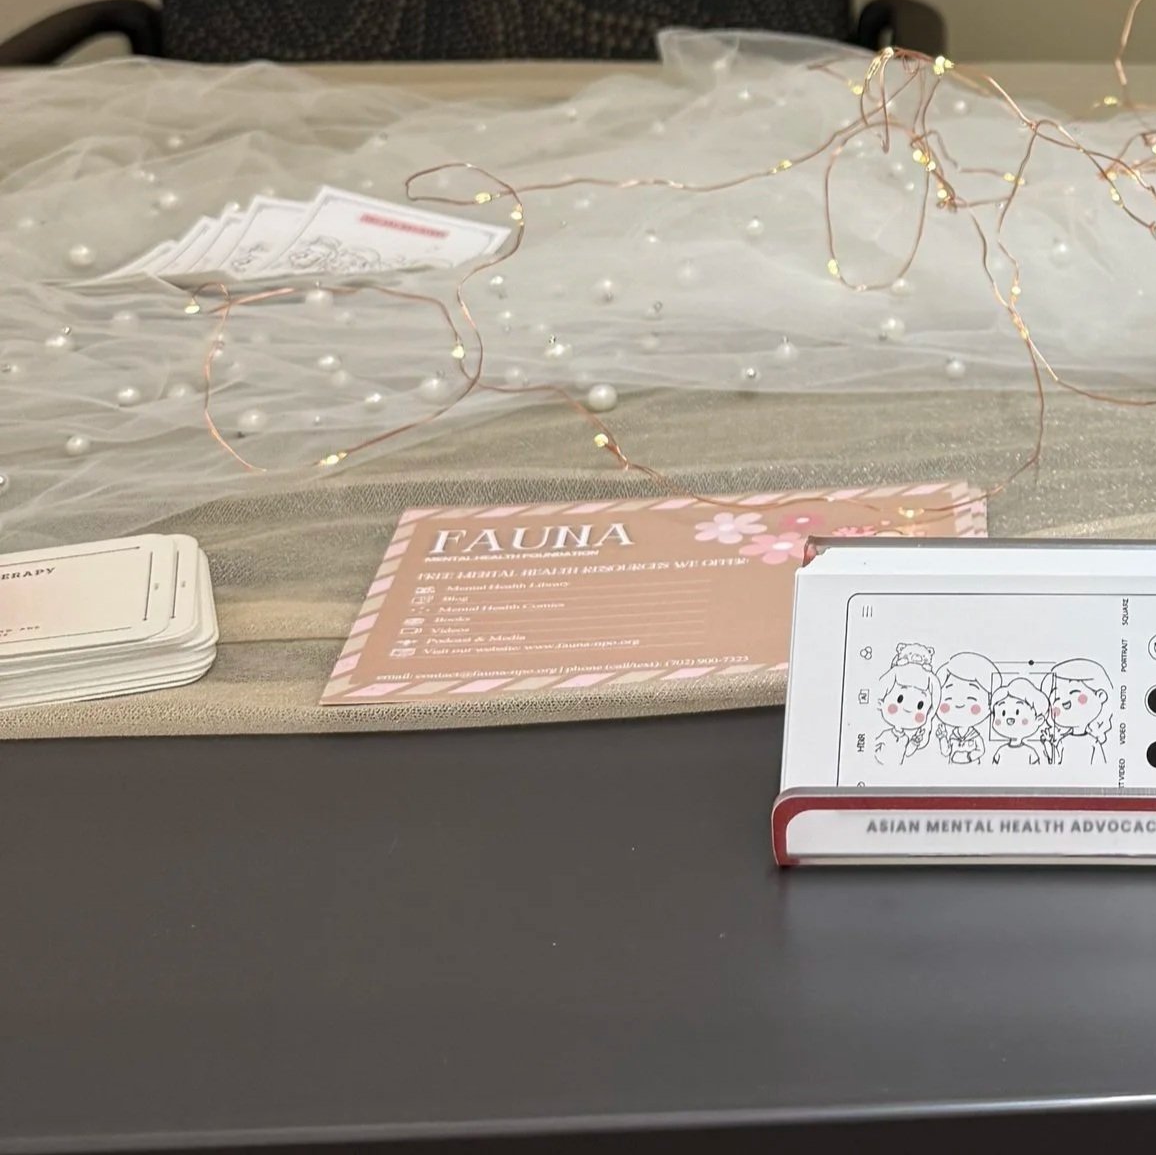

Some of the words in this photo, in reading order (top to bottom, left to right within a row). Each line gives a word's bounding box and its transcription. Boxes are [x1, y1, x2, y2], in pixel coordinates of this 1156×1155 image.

[428, 522, 636, 554] FAUNA
[1119, 684, 1127, 710] PHOTO
[1118, 722, 1127, 746] VIDEO
[866, 819, 920, 834] ASIAN
[926, 819, 995, 834] MENTAL
[999, 819, 1065, 834] HEALTH
